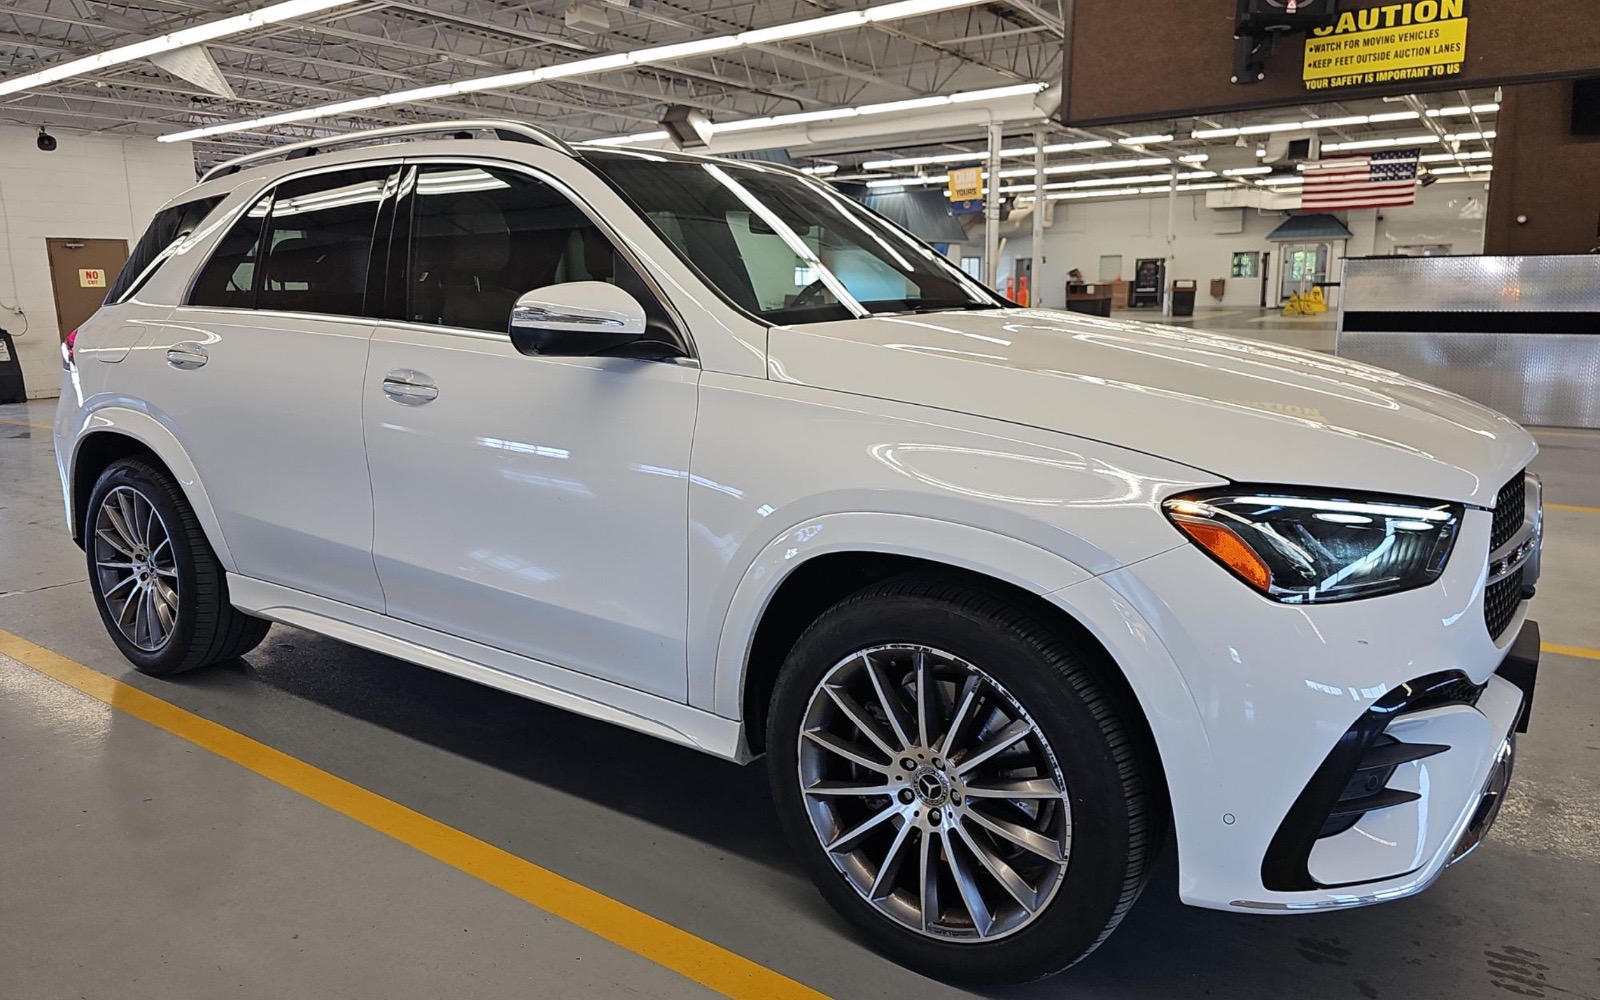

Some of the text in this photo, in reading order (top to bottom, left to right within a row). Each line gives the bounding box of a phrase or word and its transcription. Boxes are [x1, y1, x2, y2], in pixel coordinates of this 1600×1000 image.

[1313, 29, 1440, 53] WATCH FOR MOVING VEHICLES
[1312, 42, 1461, 69] KEEP FEET OUTSIDE AUCTION LANES
[1305, 63, 1460, 90] YOUR SAFETY IS IMPORTANT TO US
[86, 271, 98, 279] NO
